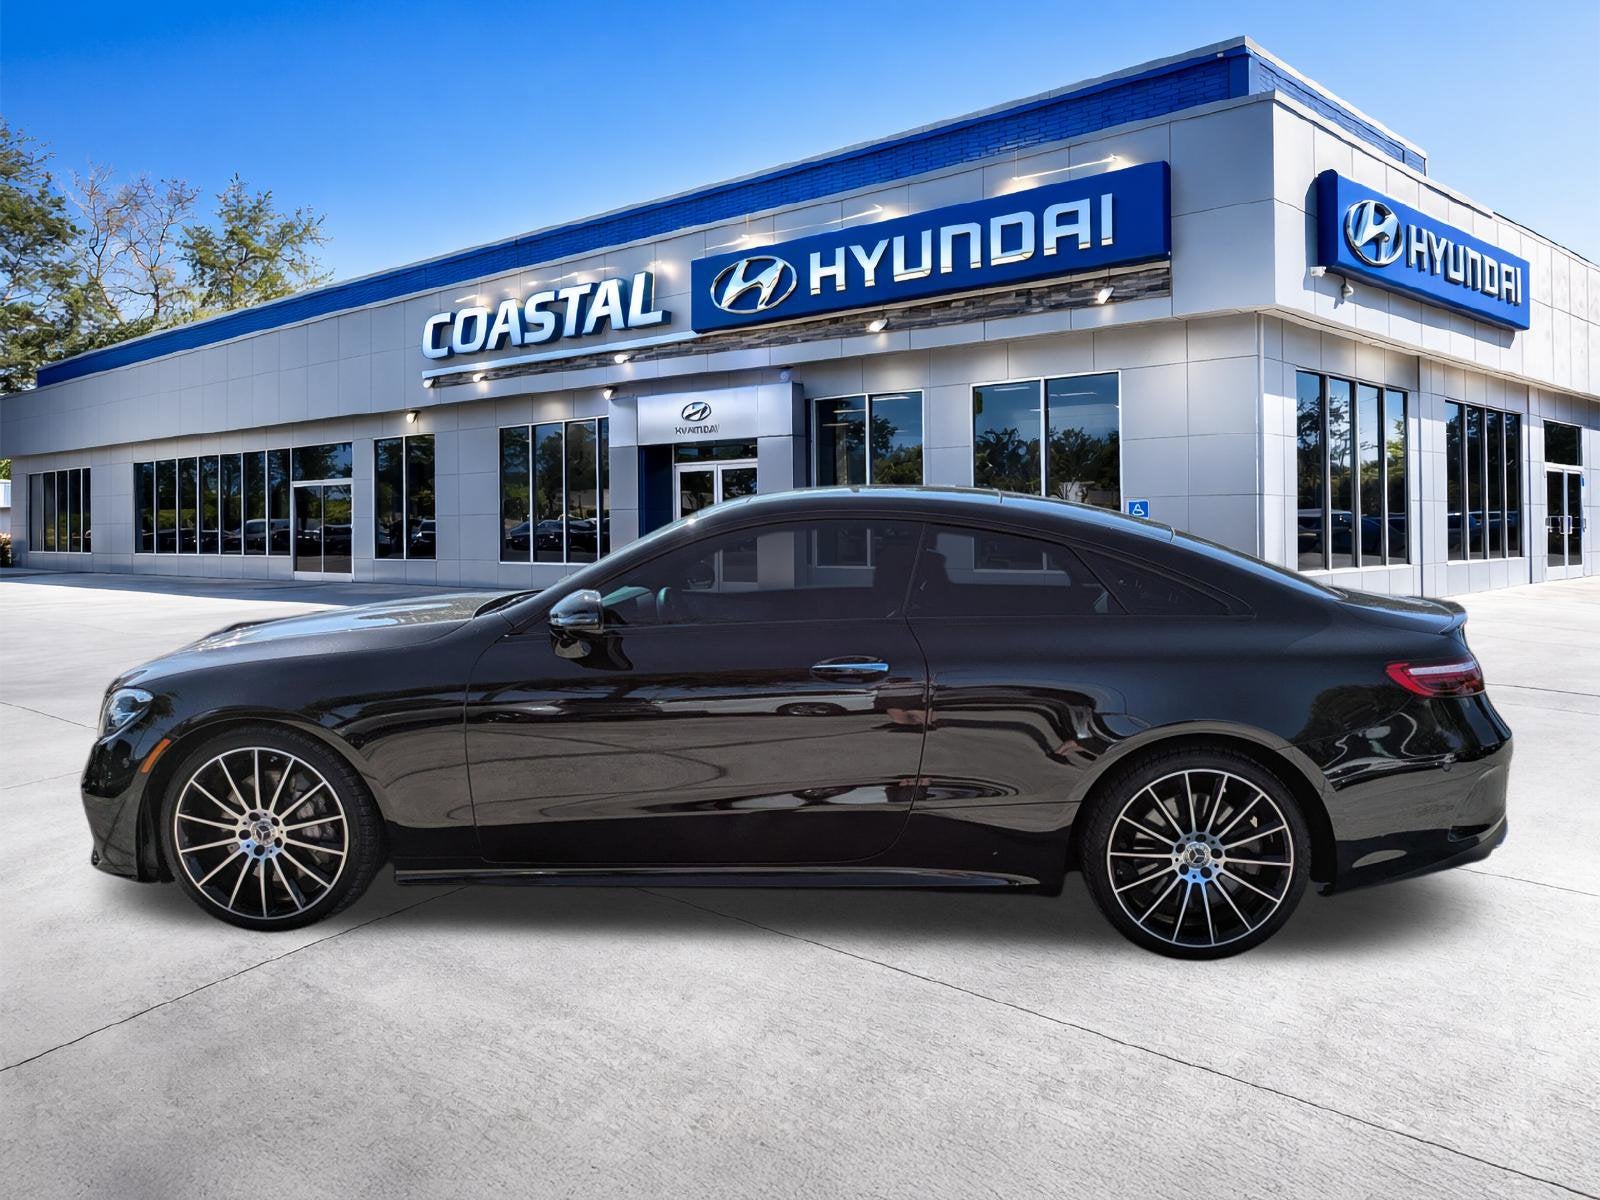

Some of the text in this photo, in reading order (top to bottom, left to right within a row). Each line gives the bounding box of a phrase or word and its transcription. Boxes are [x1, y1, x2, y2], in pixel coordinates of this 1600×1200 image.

[809, 193, 1114, 296] HYUNDAI
[1407, 224, 1522, 306] HYUNDAI
[422, 272, 666, 360] COASTAL
